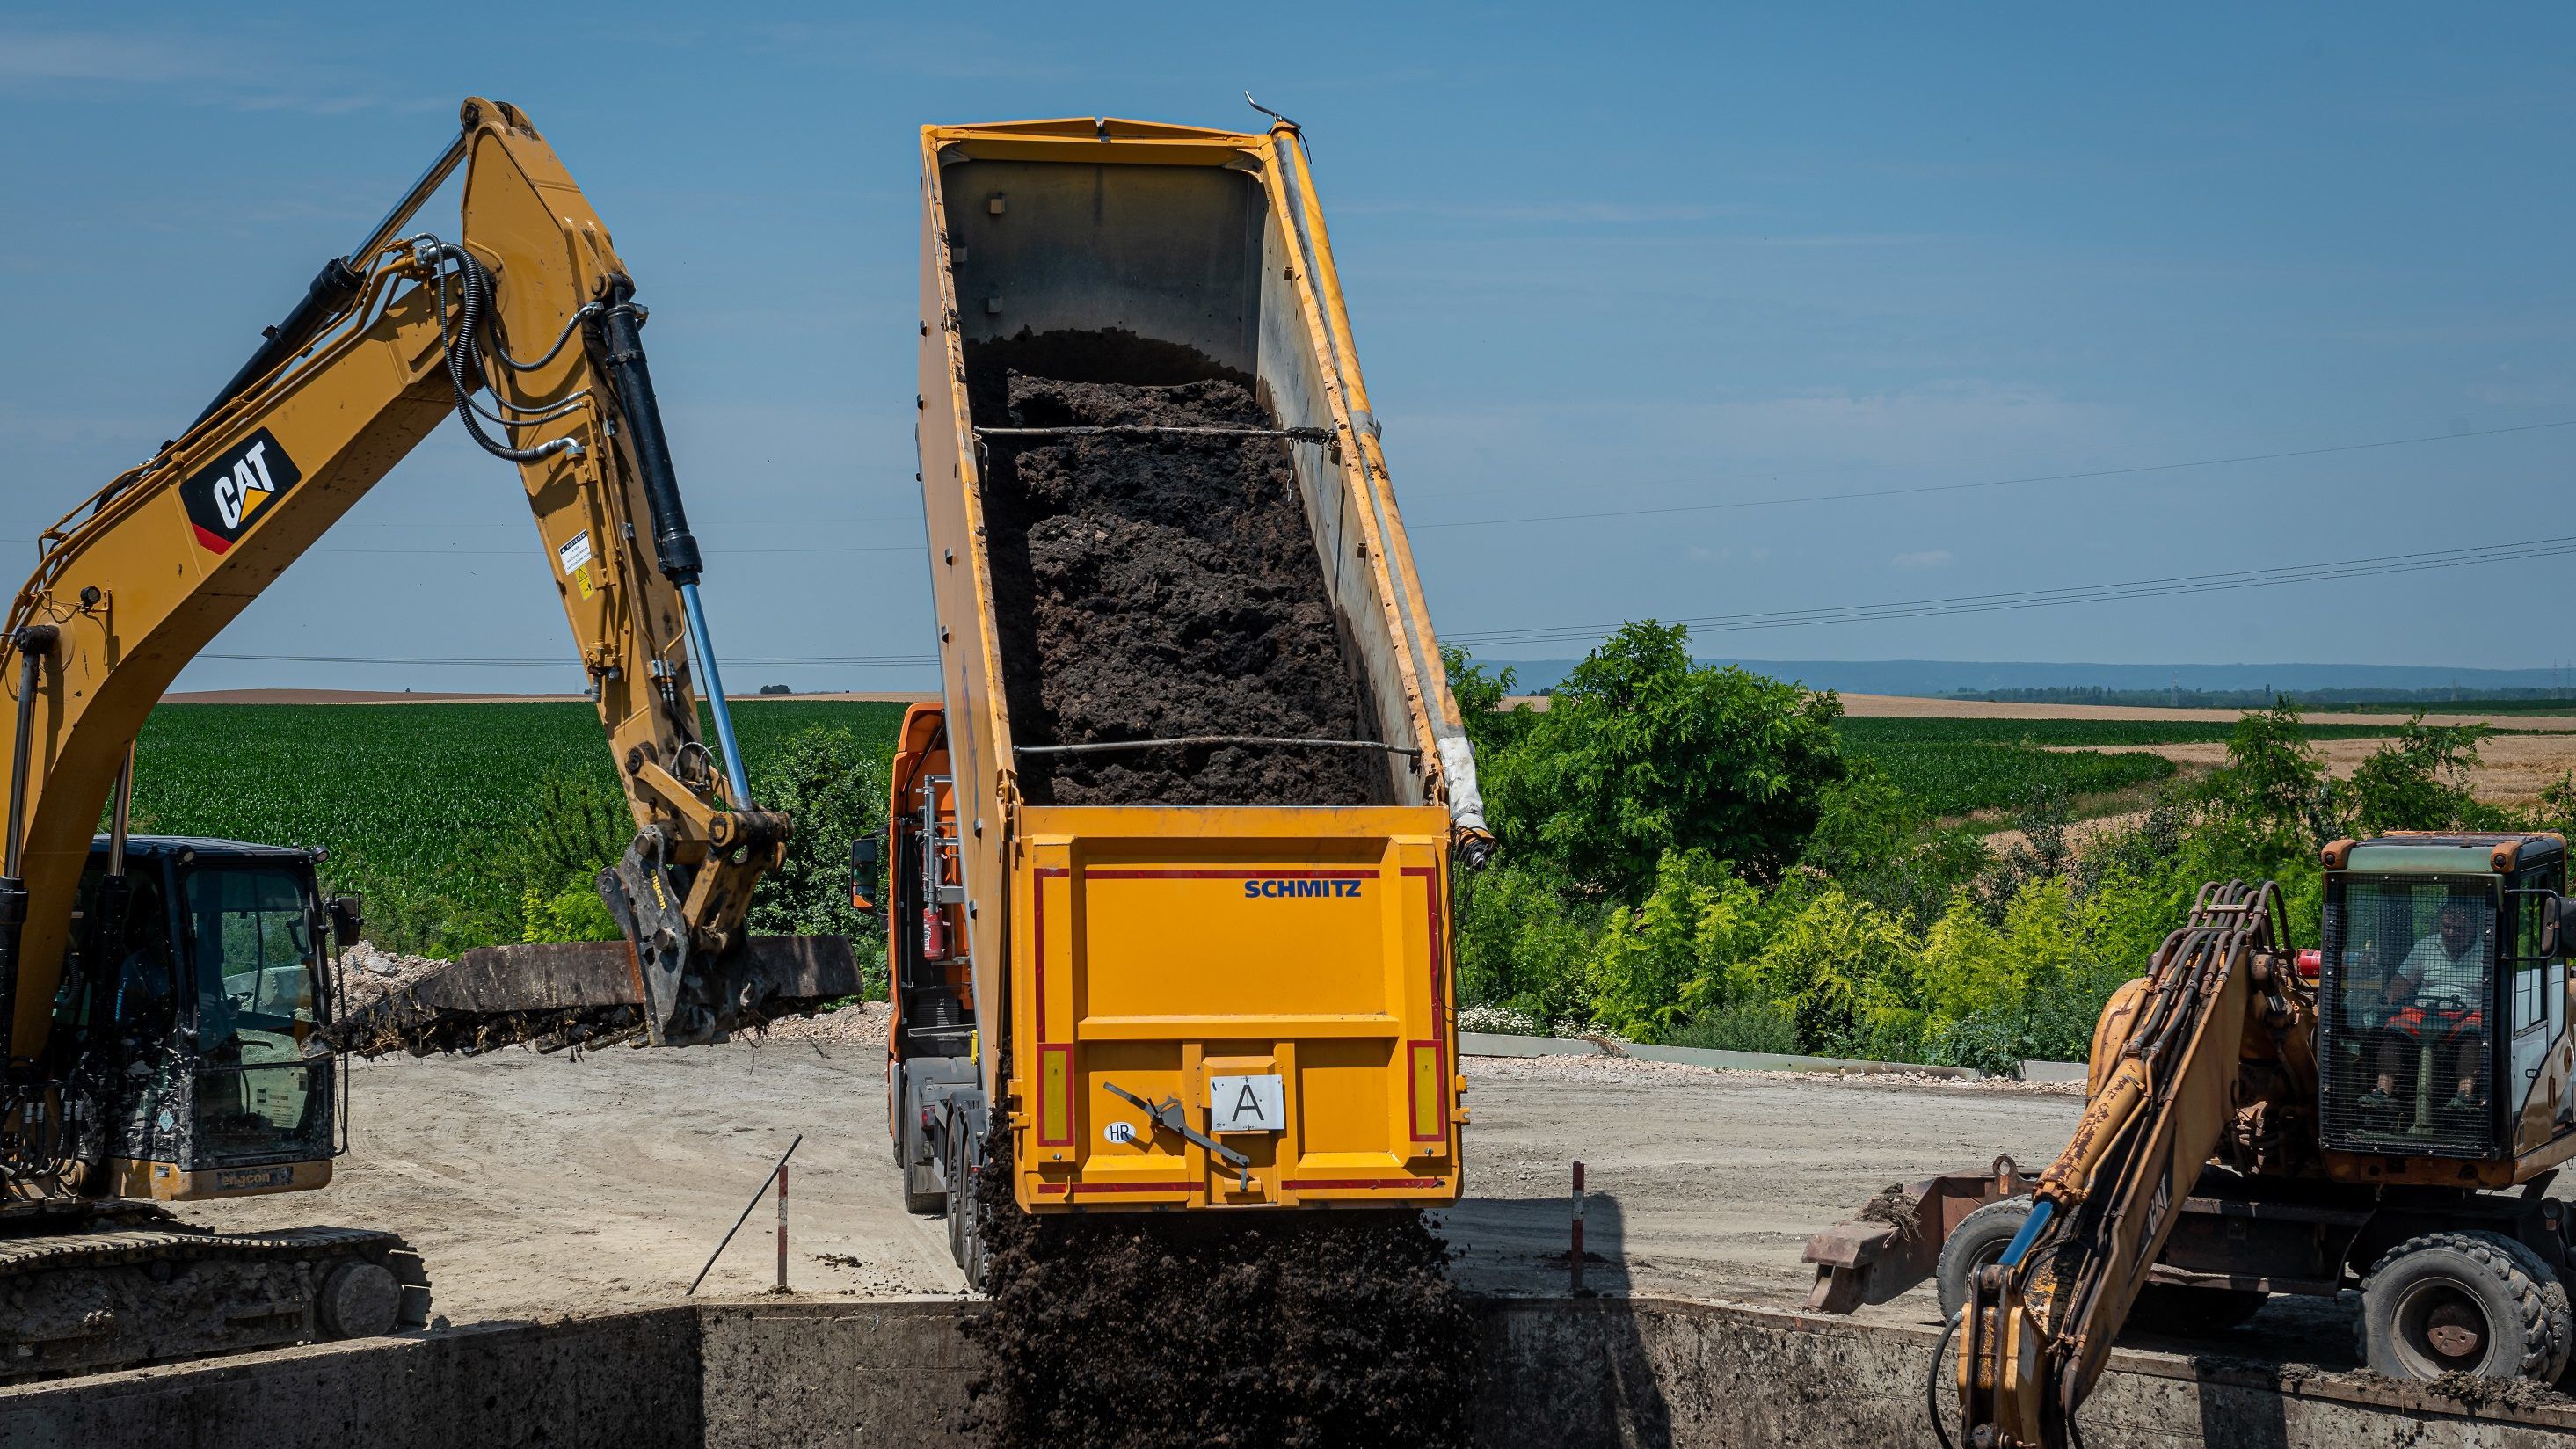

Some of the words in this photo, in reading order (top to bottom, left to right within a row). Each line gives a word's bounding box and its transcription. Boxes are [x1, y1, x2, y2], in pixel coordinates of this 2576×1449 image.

[214, 440, 274, 529] CAT
[651, 869, 666, 910] engcon
[1244, 879, 1362, 898] SCHMITZ
[1232, 1084, 1264, 1121] A
[1110, 1125, 1130, 1140] HR
